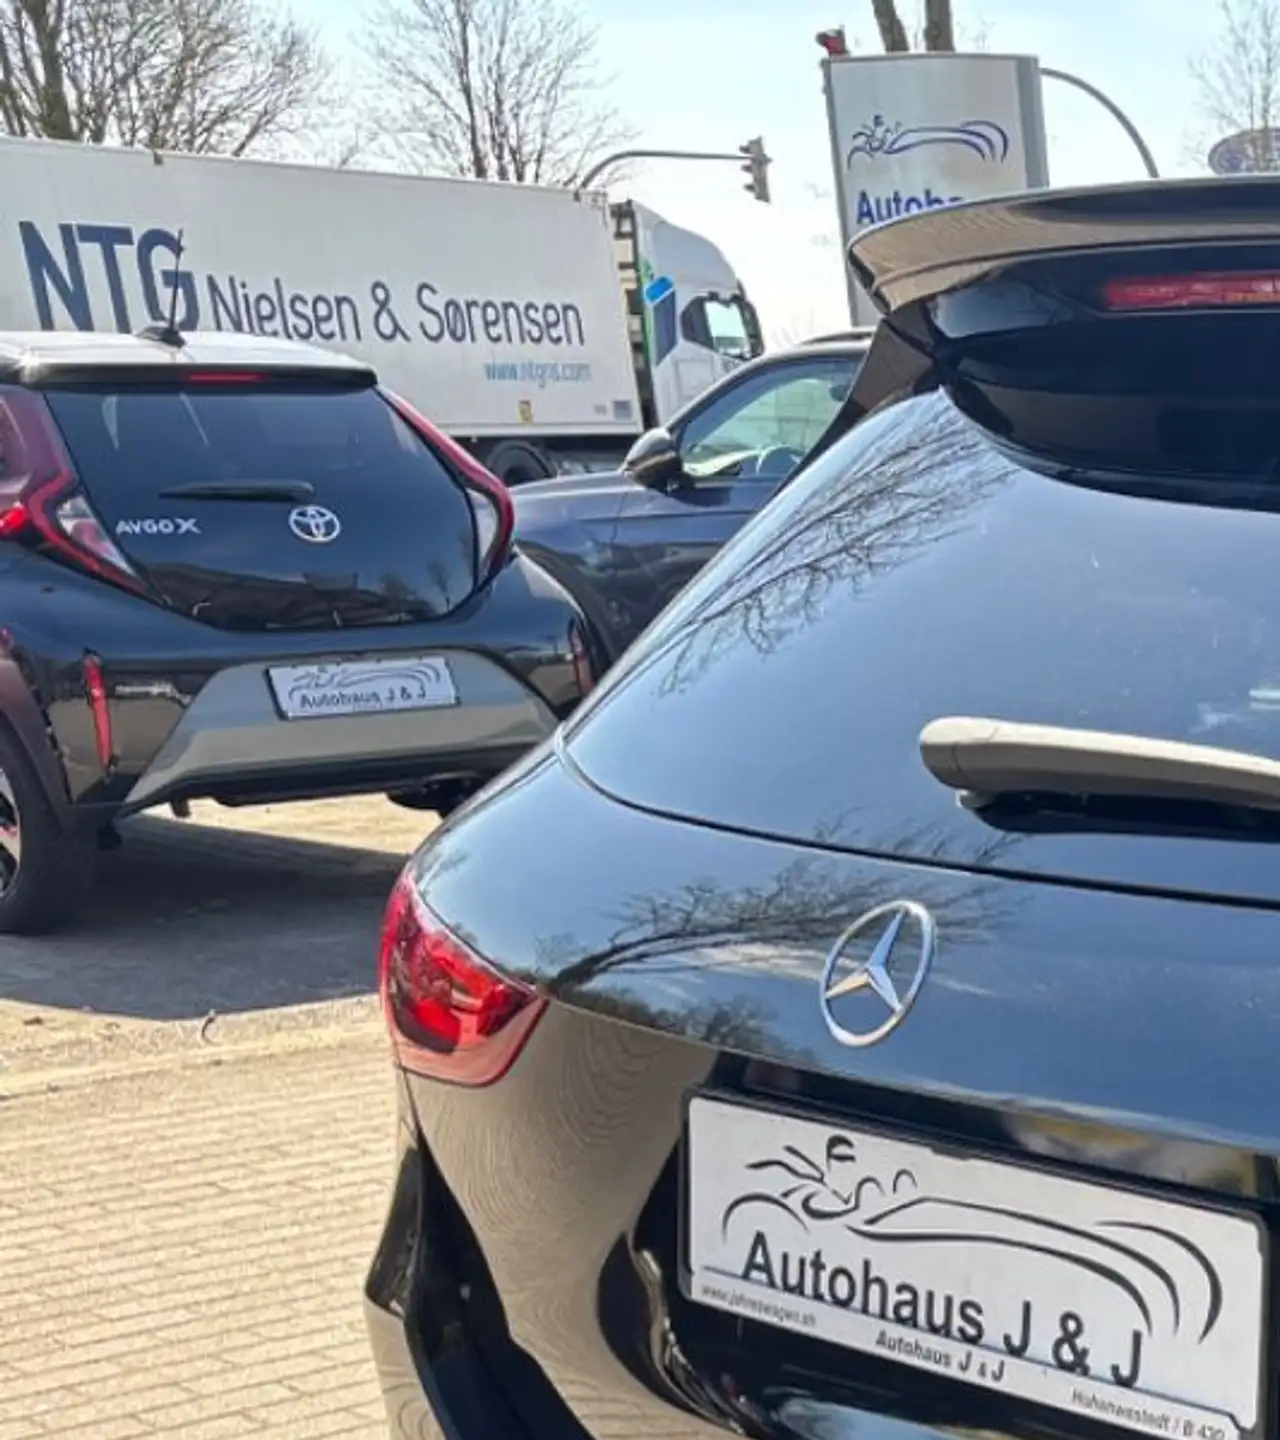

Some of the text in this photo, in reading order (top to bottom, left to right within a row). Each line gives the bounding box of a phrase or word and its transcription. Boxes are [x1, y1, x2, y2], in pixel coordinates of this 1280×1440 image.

[857, 188, 963, 225] Autoh
[18, 220, 200, 334] NTG
[206, 273, 585, 346] Nielsen & Sørensen
[174, 517, 203, 535] X
[741, 1229, 1142, 1388] Autohaus J & J
[875, 1329, 1006, 1382] Autohaus J & J
